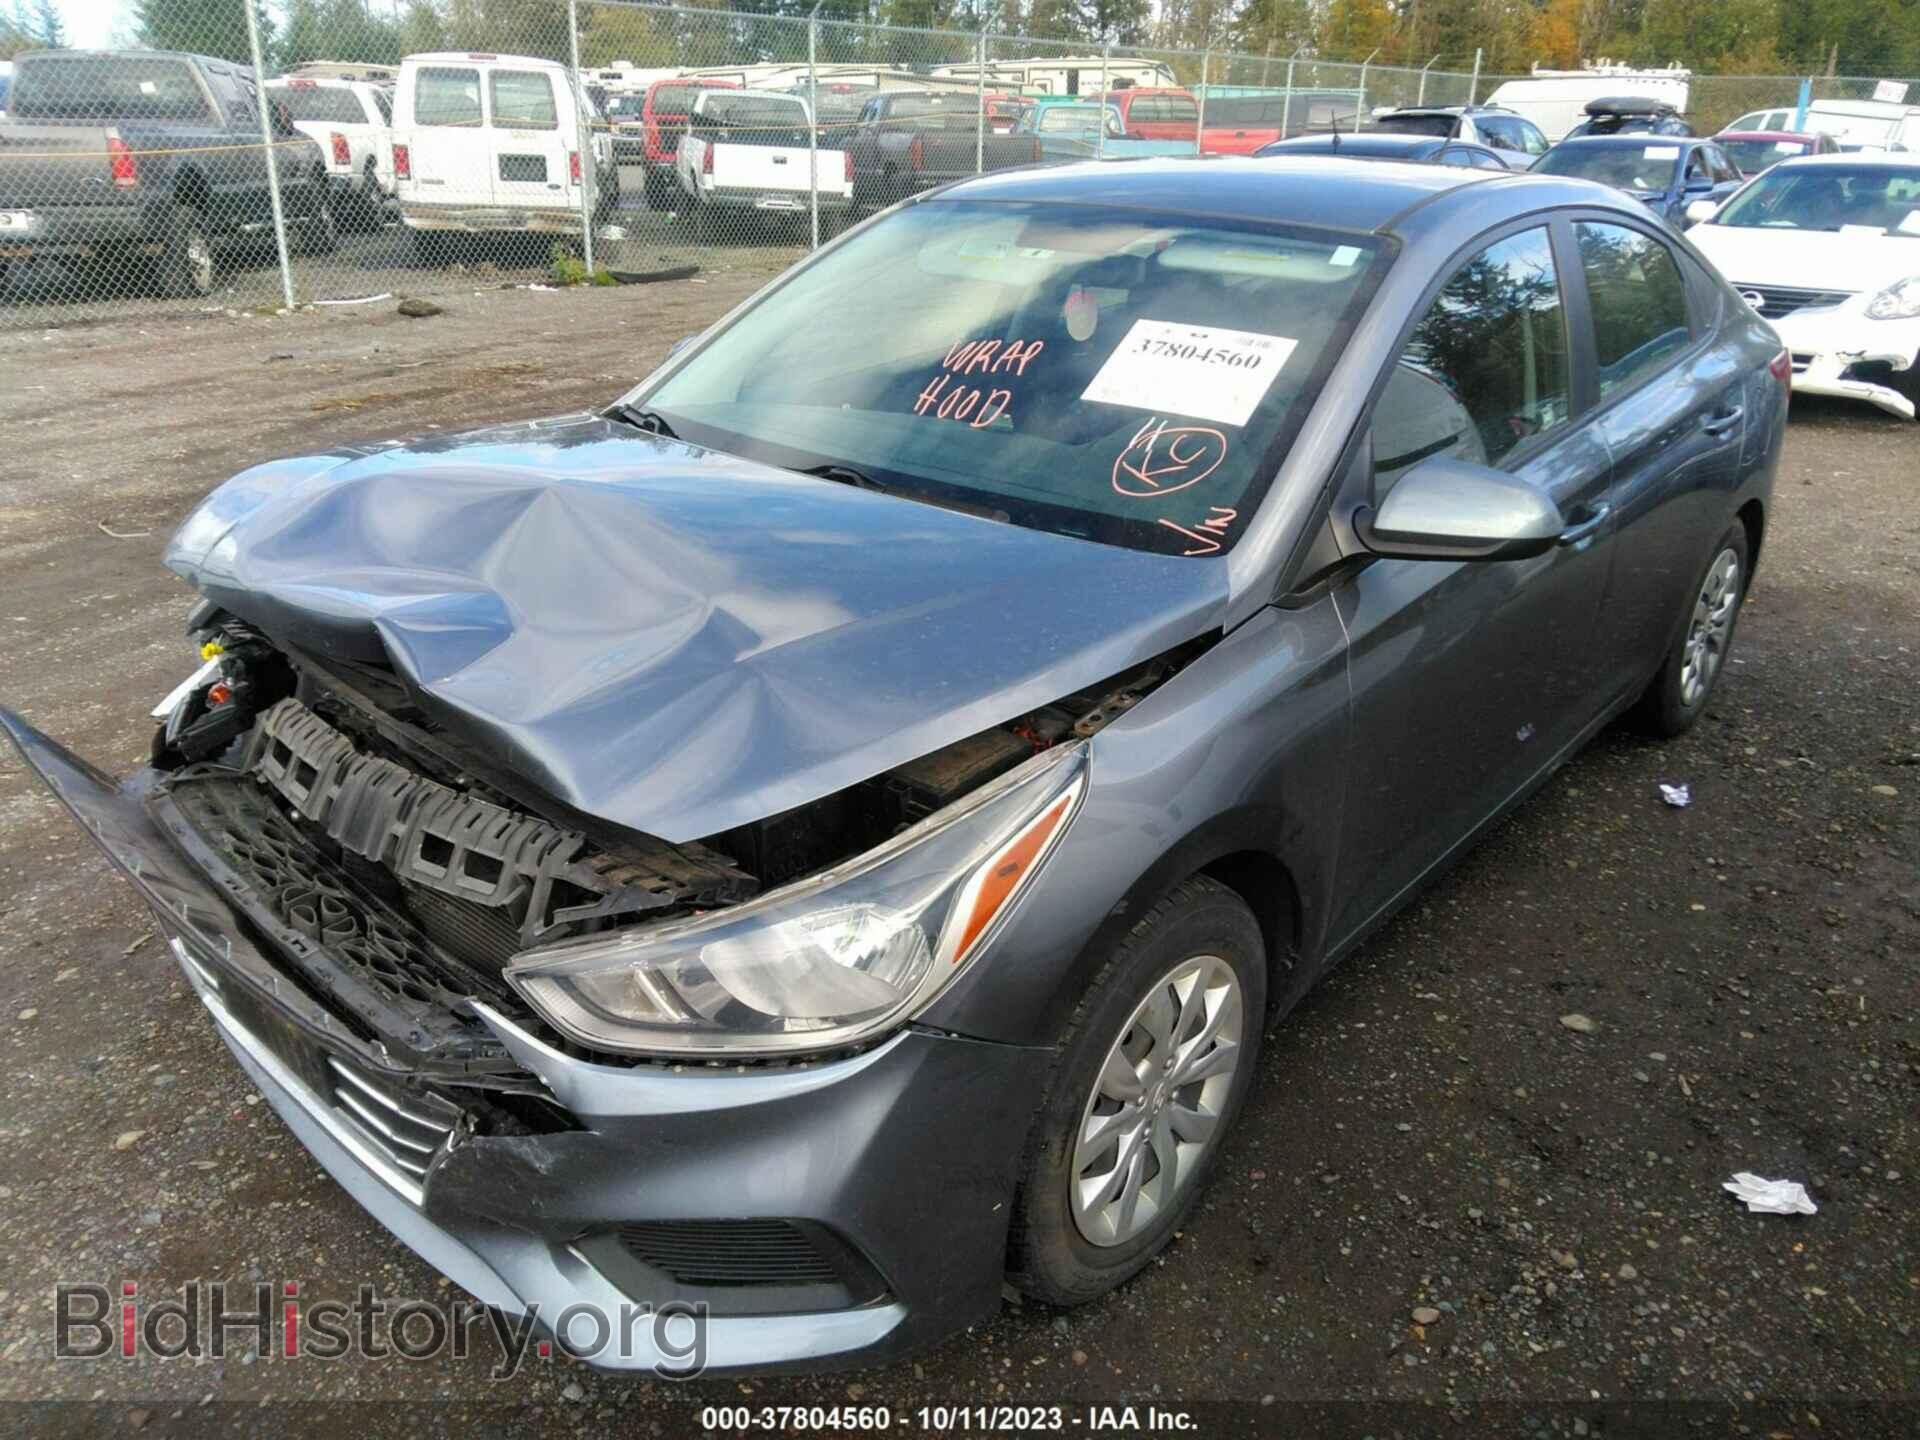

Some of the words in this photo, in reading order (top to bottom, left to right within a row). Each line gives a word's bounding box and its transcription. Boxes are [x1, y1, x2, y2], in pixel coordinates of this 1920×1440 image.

[942, 339, 1044, 376] WRAP
[1132, 338, 1262, 370] 37804560
[913, 374, 1011, 428] HOOD
